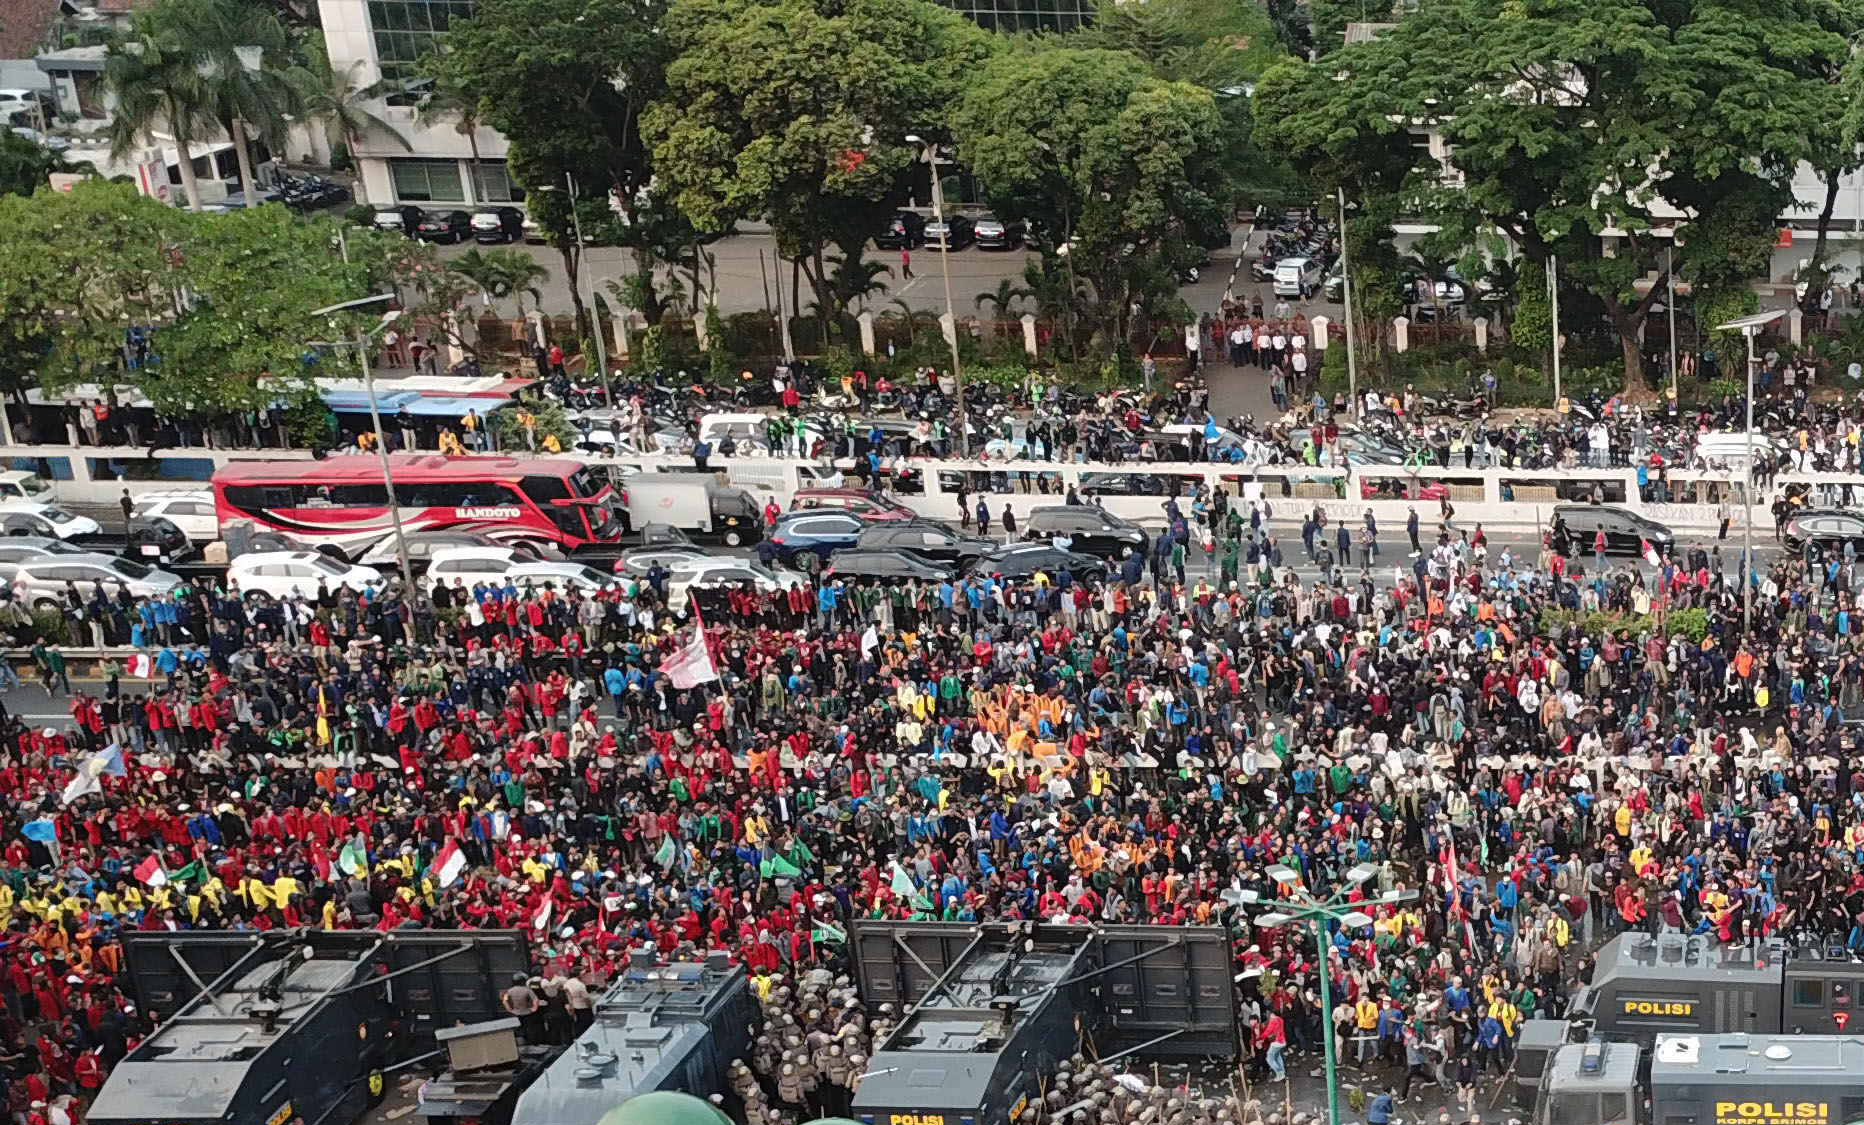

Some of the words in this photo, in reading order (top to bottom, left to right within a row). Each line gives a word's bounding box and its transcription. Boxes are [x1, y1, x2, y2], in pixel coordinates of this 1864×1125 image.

[455, 507, 521, 518] HANDOYO
[1625, 1001, 1691, 1016] POLISI
[1716, 1102, 1828, 1117] POLISI
